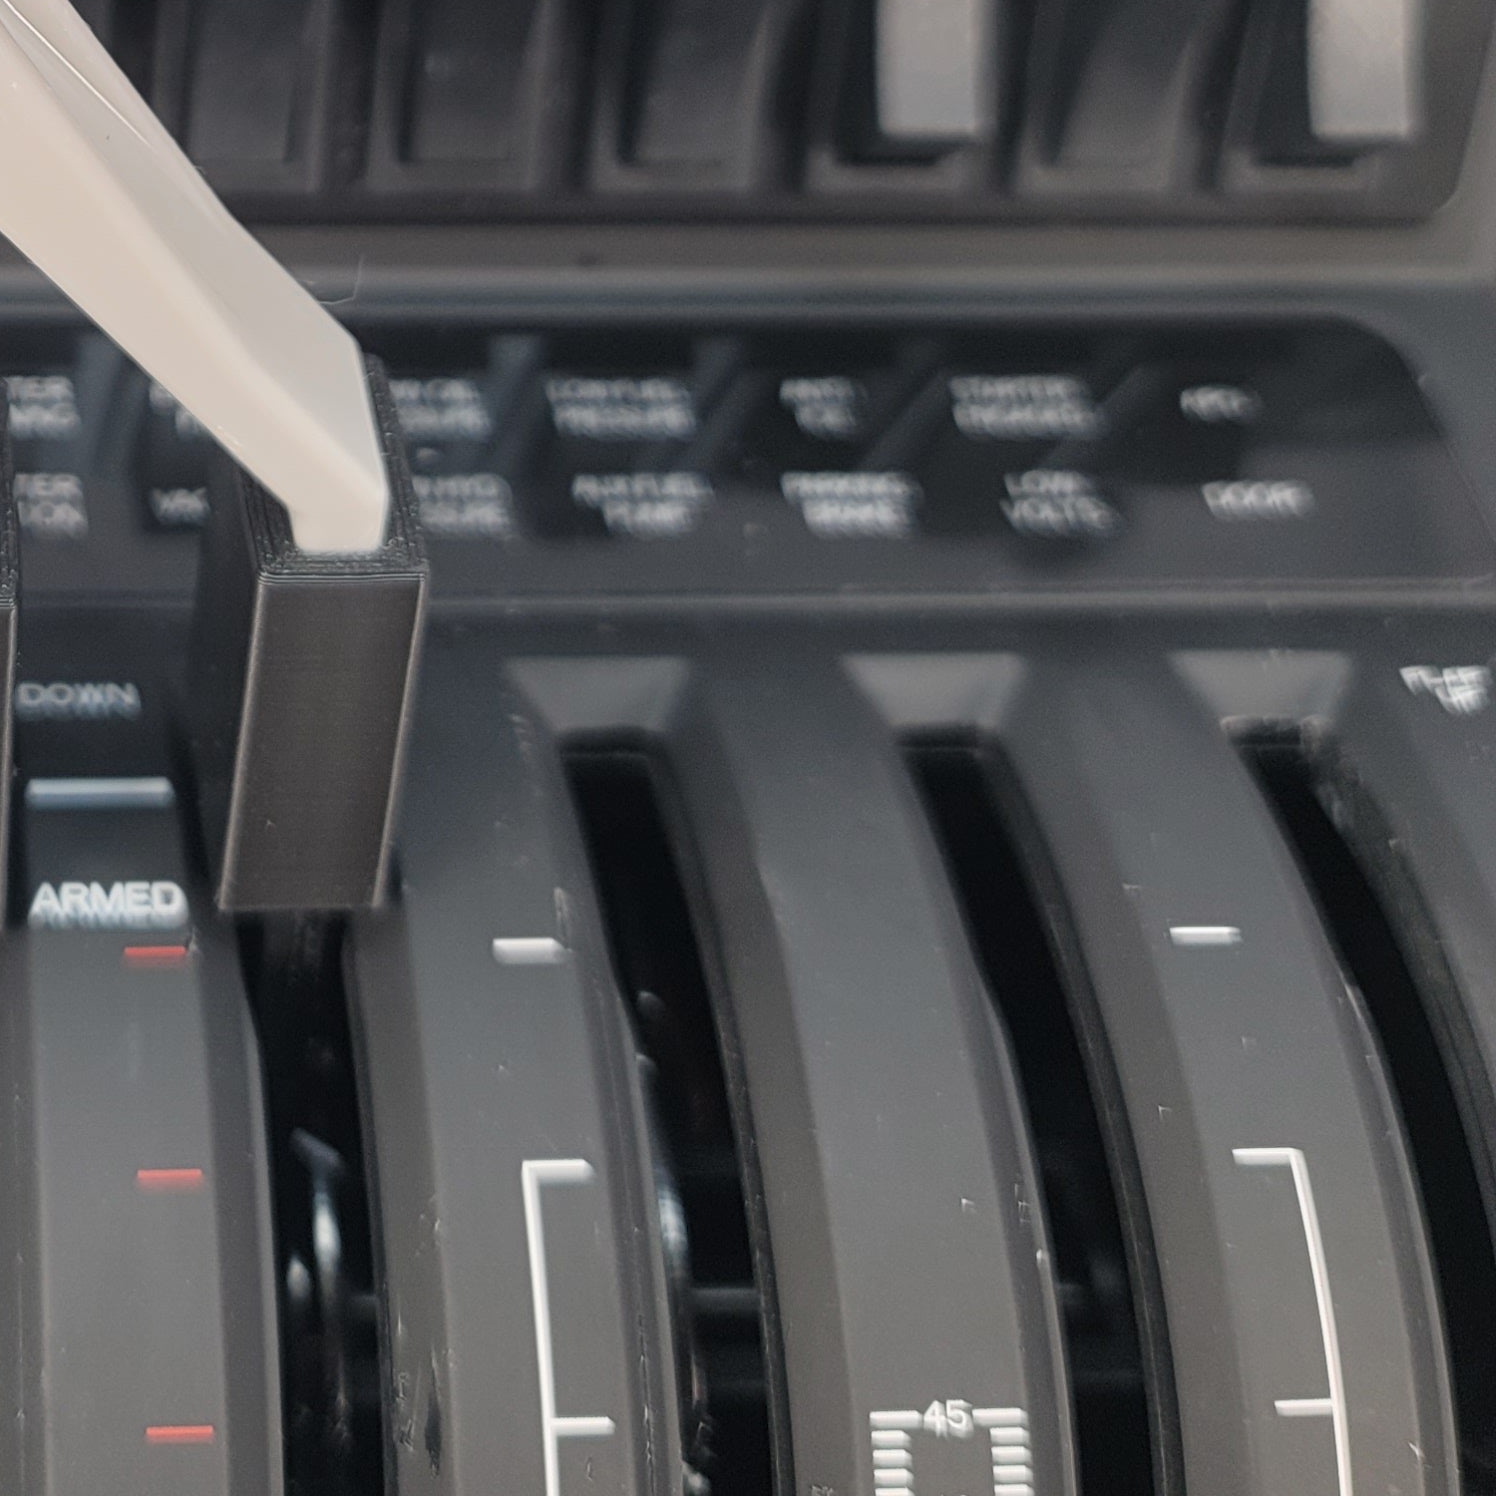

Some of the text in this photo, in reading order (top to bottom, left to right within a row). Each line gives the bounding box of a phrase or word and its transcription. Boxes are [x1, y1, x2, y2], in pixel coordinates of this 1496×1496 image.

[15, 682, 141, 720] DOWN
[27, 881, 189, 929] ARMED
[923, 1399, 974, 1439] 45
